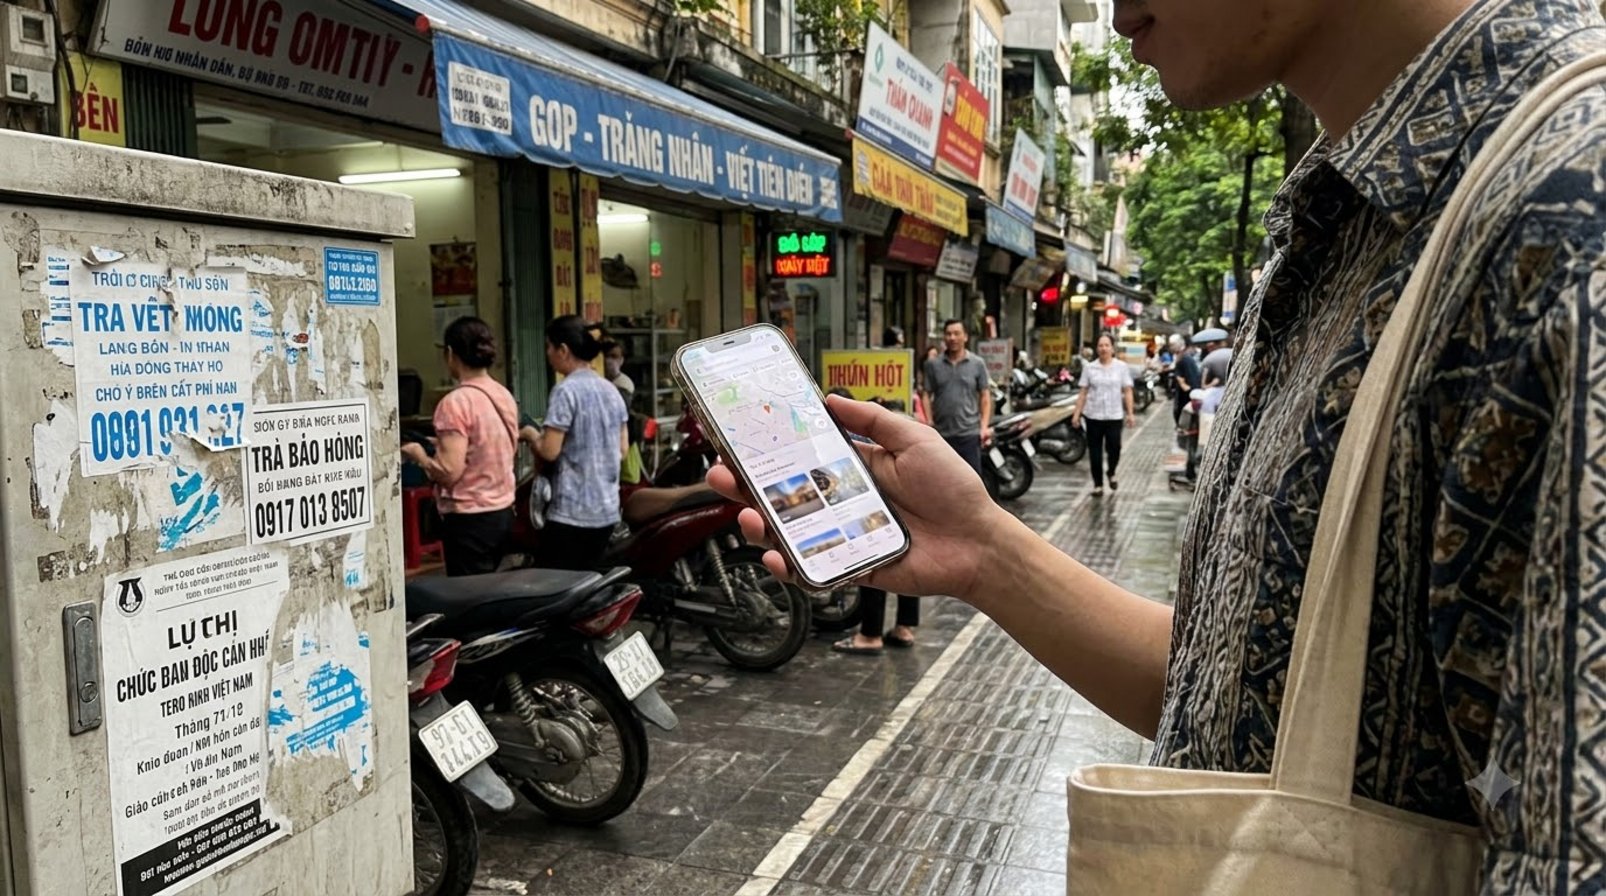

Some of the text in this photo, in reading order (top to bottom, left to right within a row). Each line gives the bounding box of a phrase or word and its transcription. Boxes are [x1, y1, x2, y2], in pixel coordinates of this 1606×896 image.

[529, 95, 577, 152] GOP
[667, 131, 714, 185] NHÂN
[78, 302, 125, 332] TRA
[255, 498, 294, 538] 0917
[300, 493, 327, 529] 013
[331, 486, 365, 522] 8507
[161, 659, 189, 689] BAN
[233, 672, 253, 694] NAM
